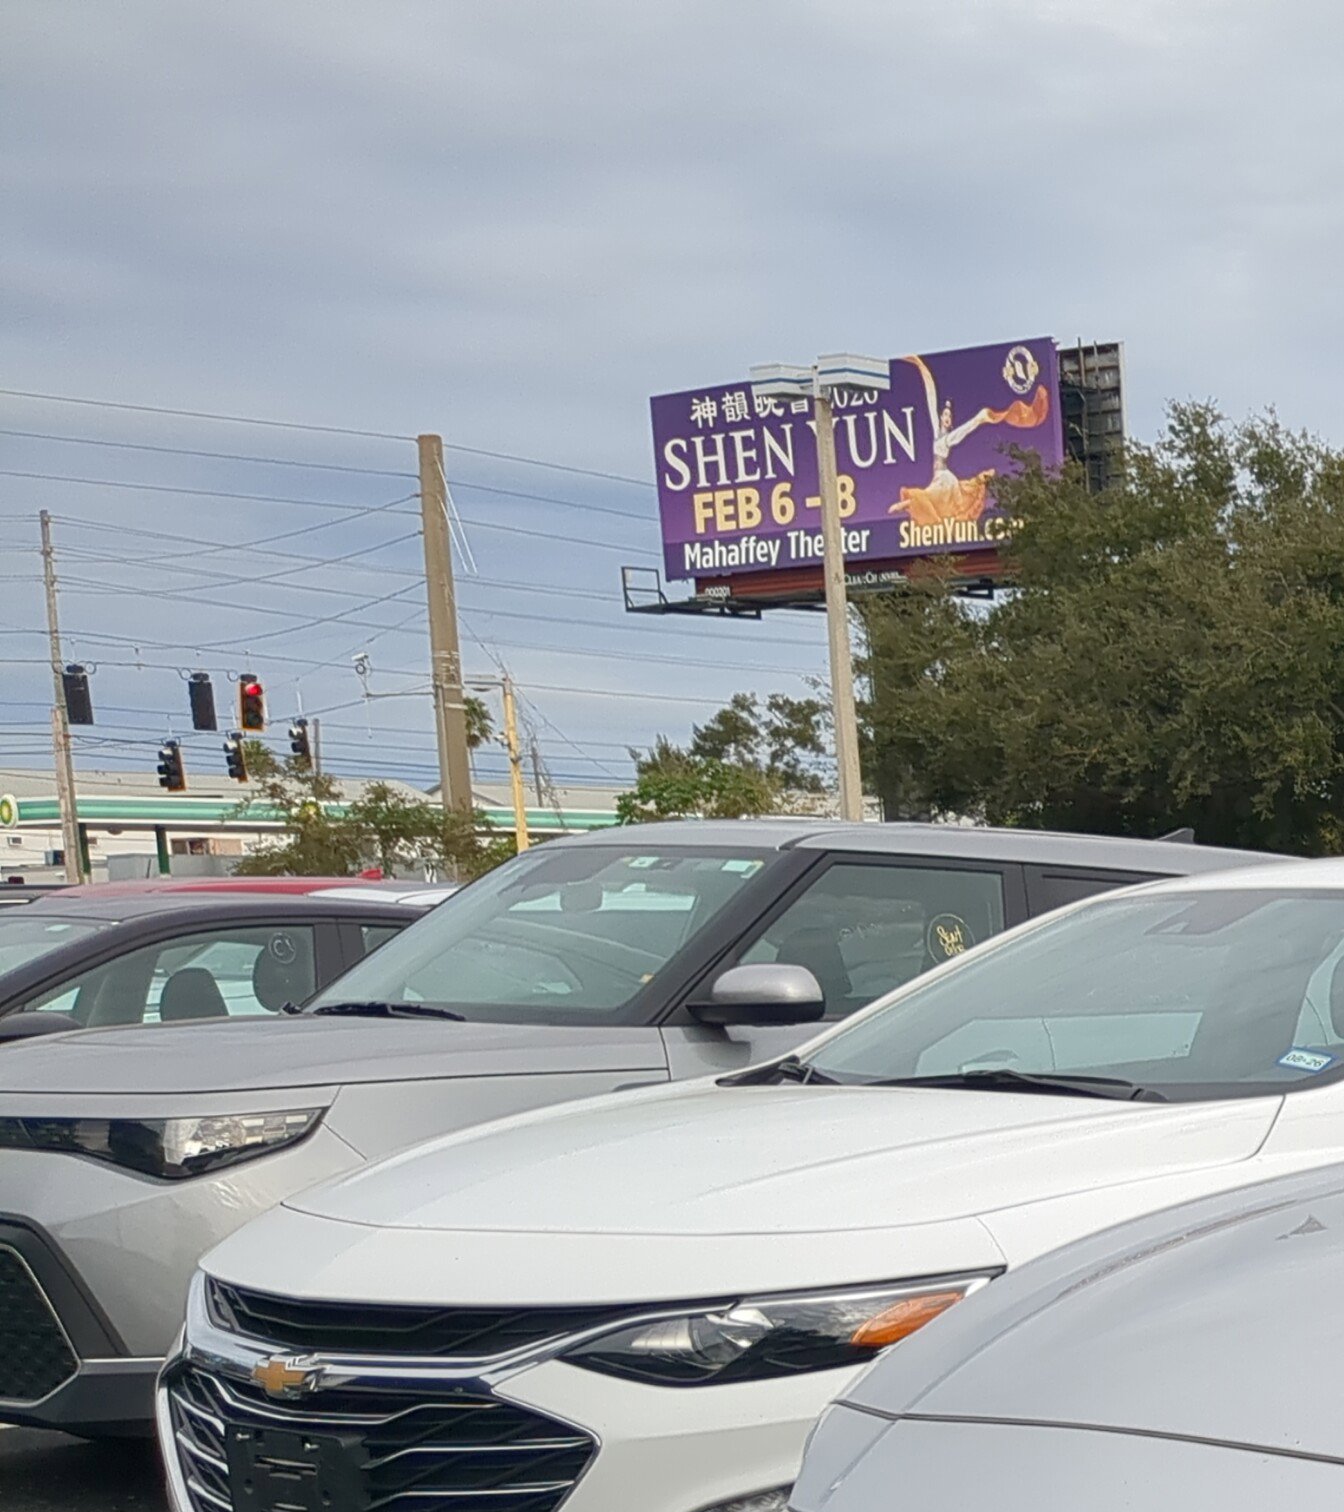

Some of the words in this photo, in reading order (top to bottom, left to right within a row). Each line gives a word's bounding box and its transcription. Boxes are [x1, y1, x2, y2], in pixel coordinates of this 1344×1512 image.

[664, 422, 795, 492] SHEN
[692, 487, 763, 534] FEB
[770, 482, 795, 526] 6
[836, 474, 857, 519] 8
[684, 535, 781, 571] Mahaffey
[787, 528, 870, 561] Theter
